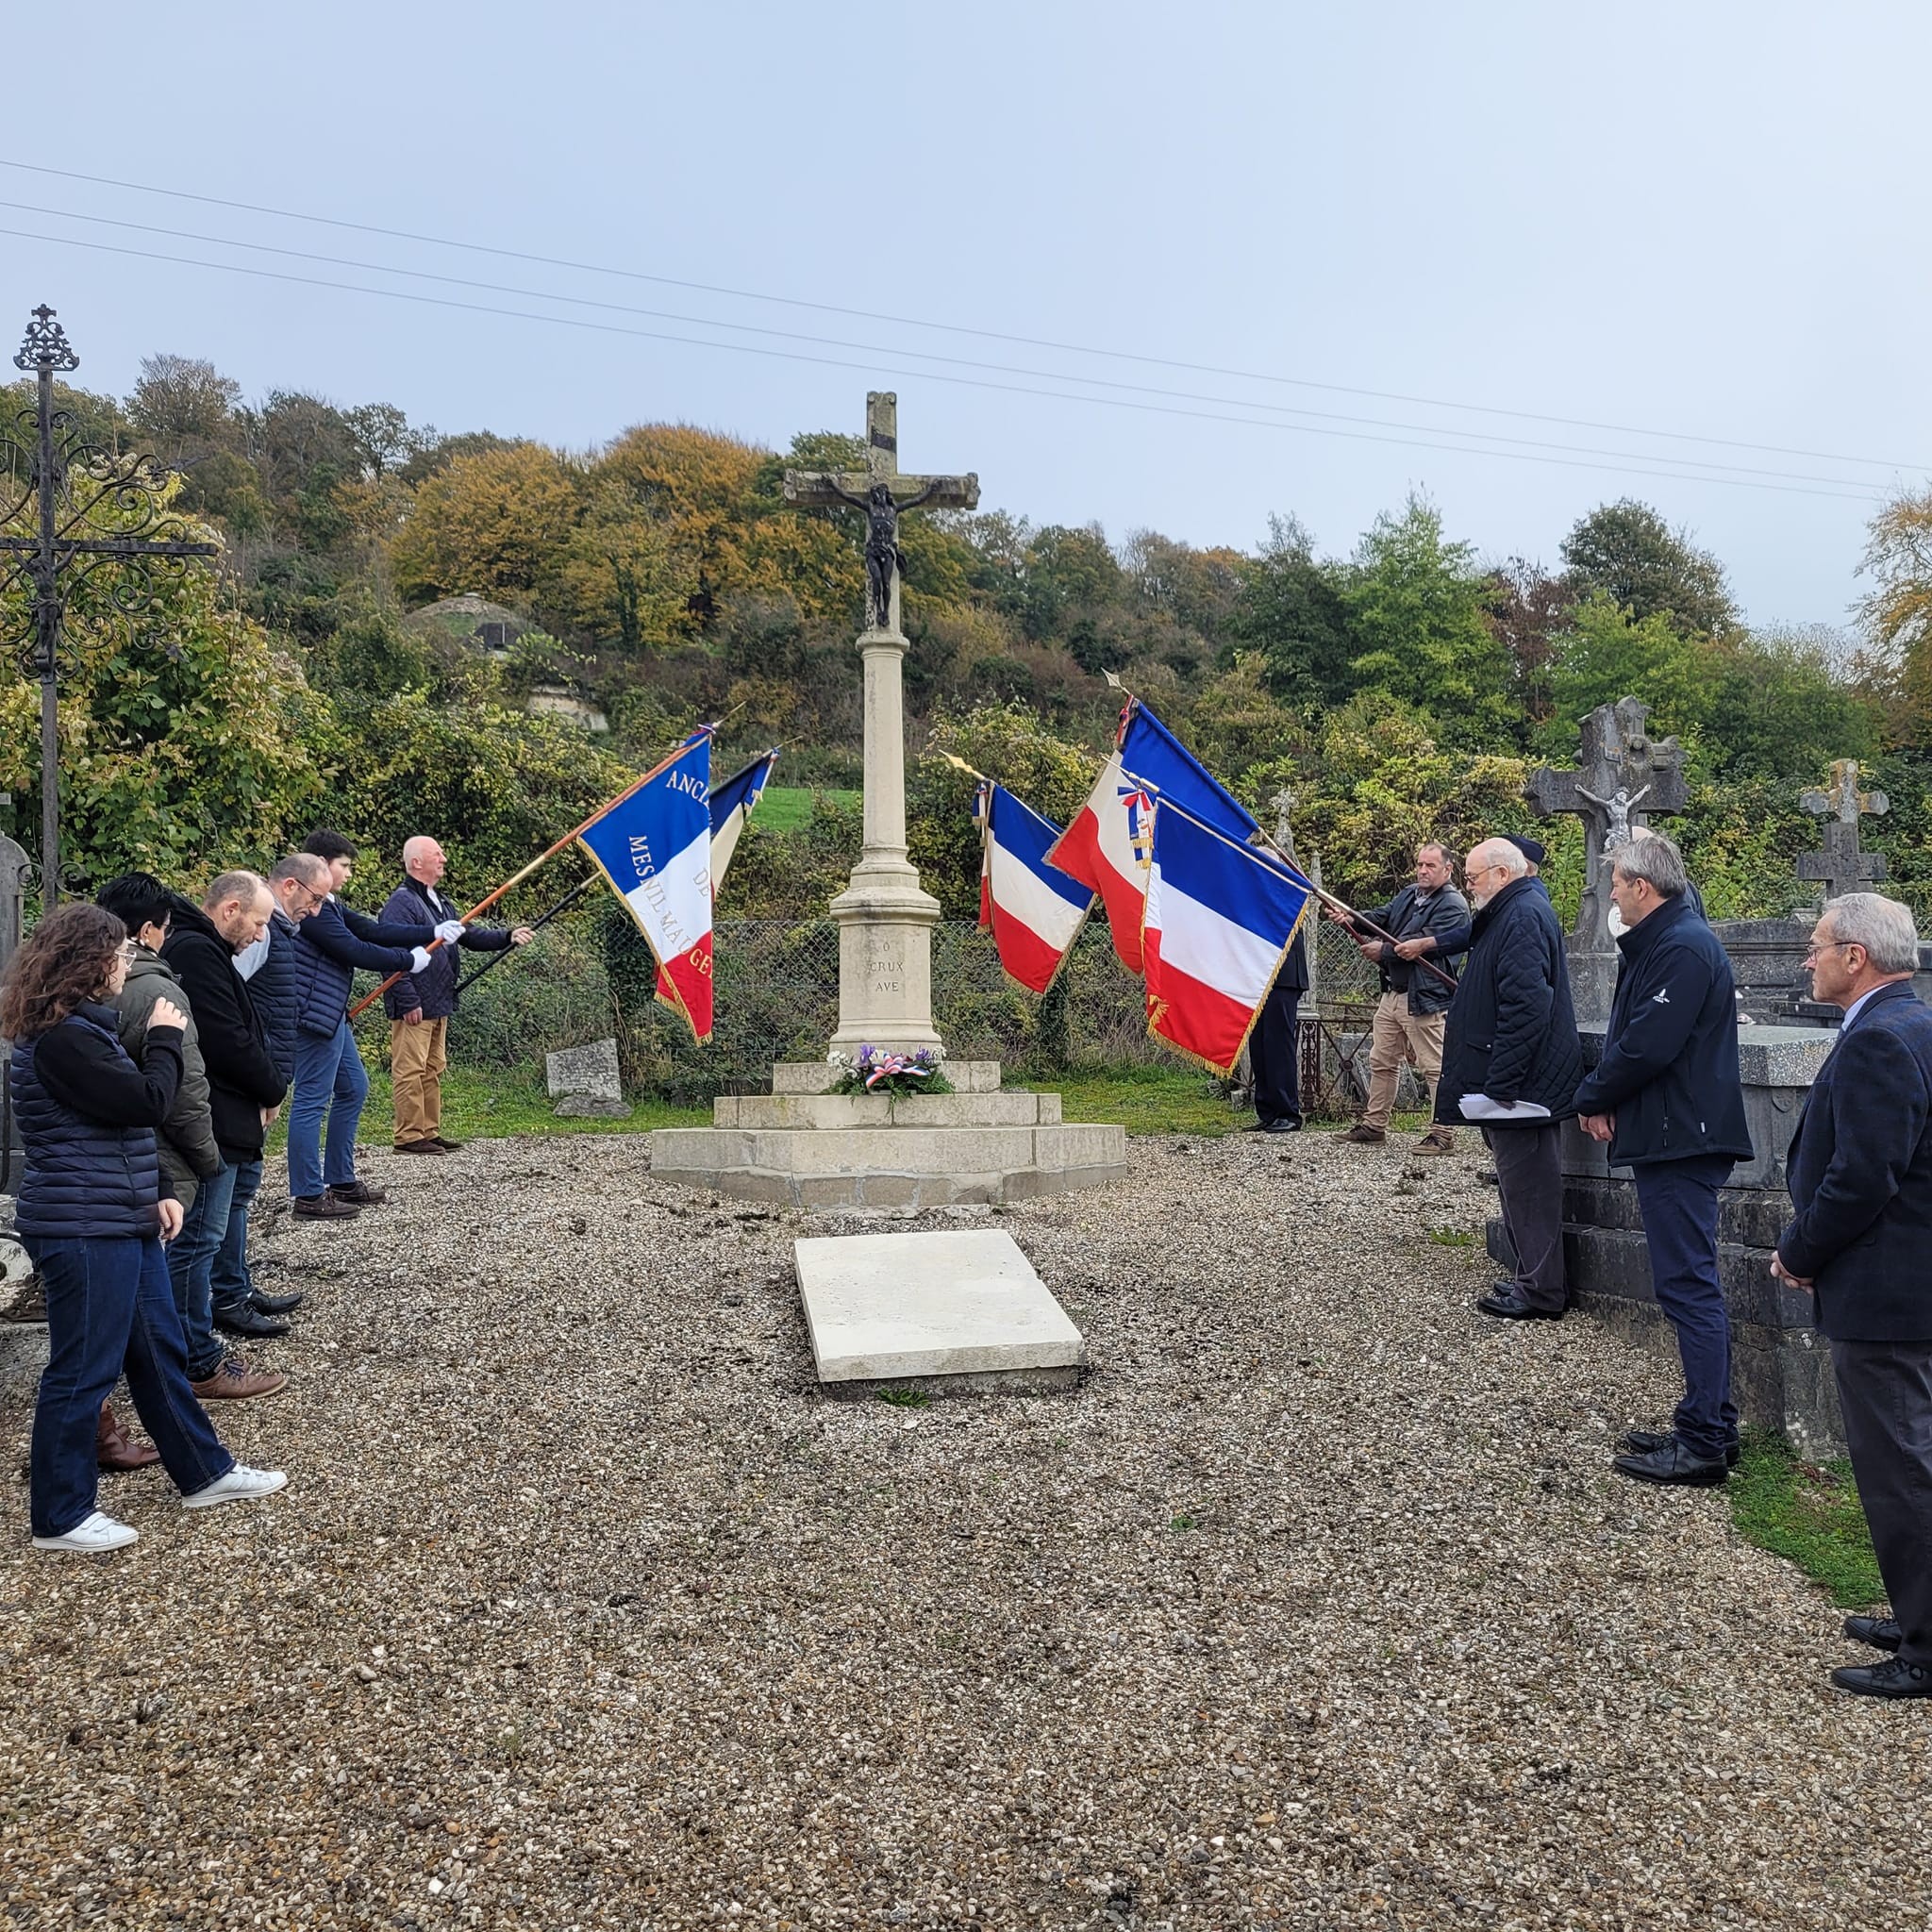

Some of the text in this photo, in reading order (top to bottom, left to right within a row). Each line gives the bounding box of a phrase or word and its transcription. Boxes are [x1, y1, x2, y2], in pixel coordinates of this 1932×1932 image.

[629, 836, 712, 979] MESNIL MAUGE
[870, 961, 904, 972] CRUX
[875, 981, 899, 992] AVE
